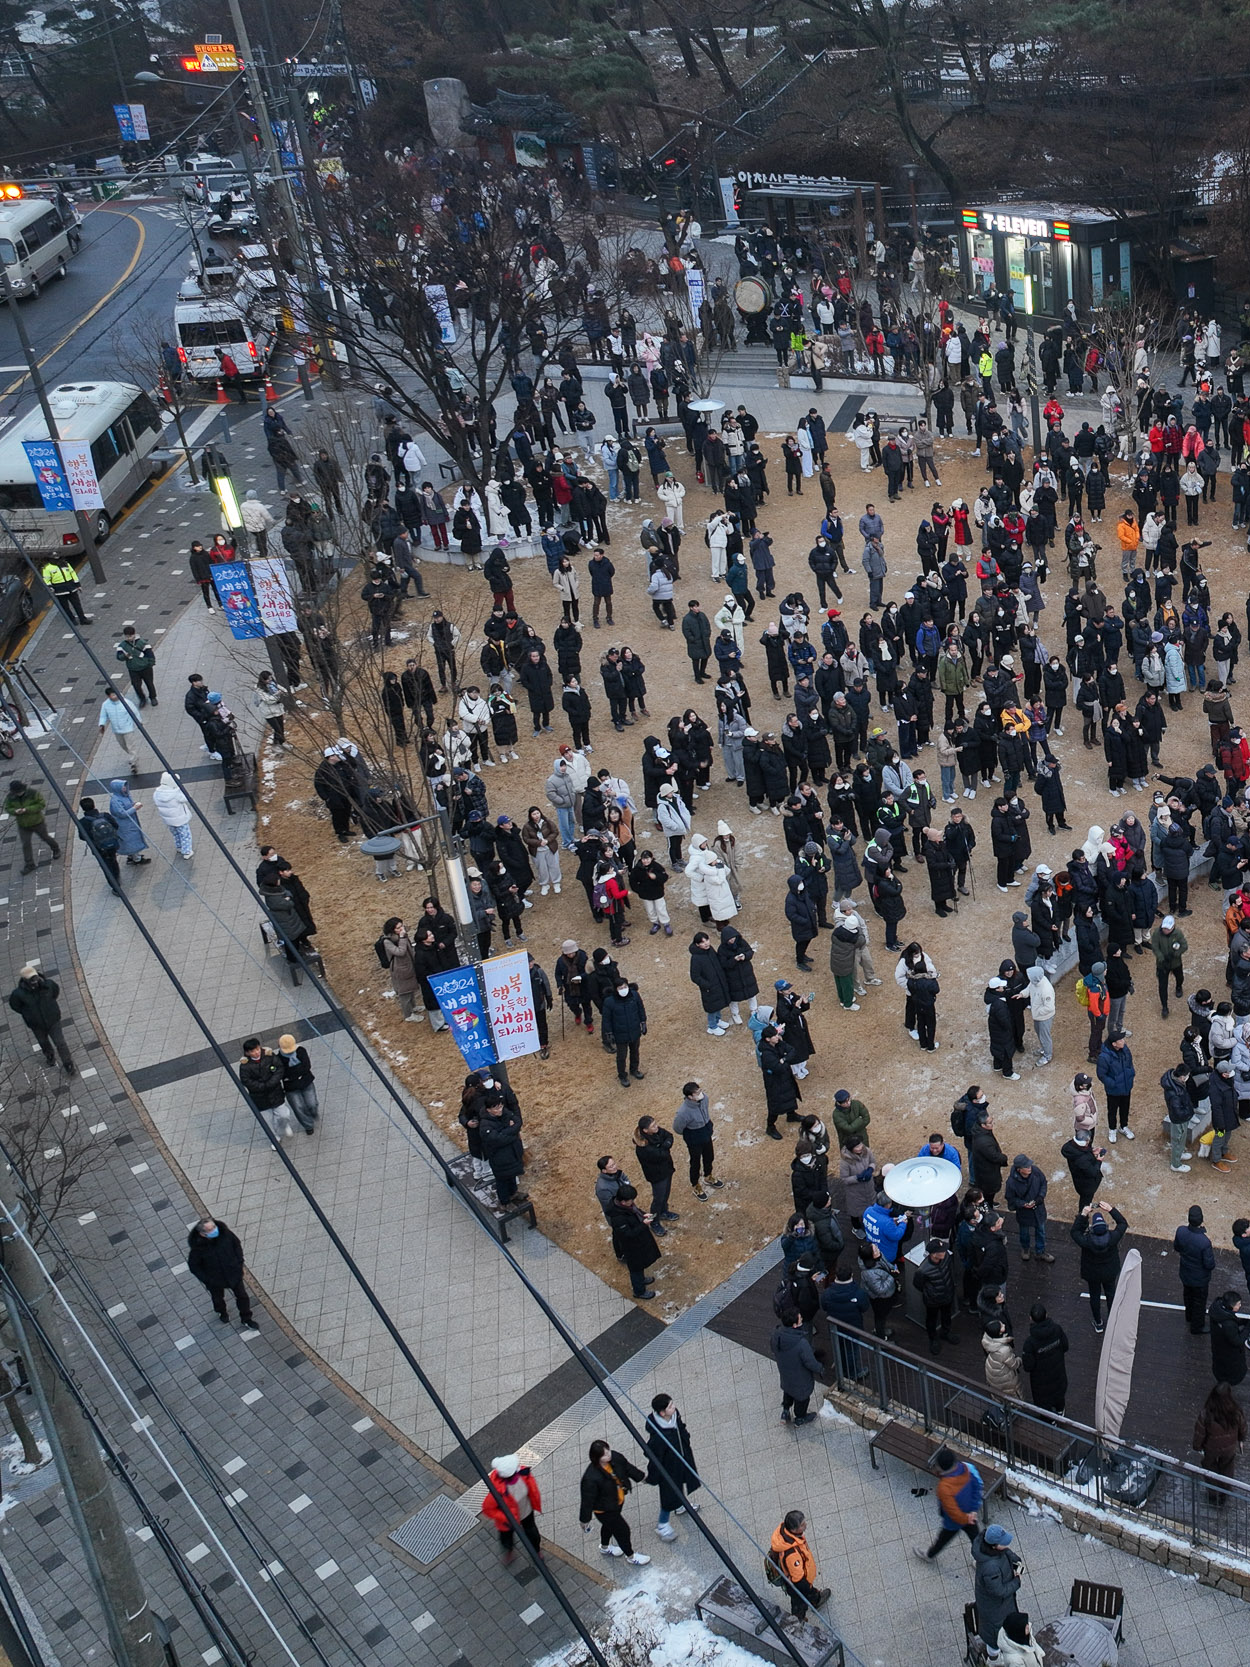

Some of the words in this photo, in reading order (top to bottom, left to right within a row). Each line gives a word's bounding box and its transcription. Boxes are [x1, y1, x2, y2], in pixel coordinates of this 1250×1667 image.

[34, 459, 58, 467] 새해
[67, 453, 89, 470] 행복
[71, 469, 94, 479] 가득한
[71, 479, 97, 488] 새해
[221, 580, 249, 591] 새해
[258, 572, 281, 591] 행복
[233, 595, 244, 610] 복
[261, 600, 291, 610] 새해
[265, 611, 293, 619] 되세요
[491, 972, 523, 1001] 행복
[495, 996, 528, 1012] 가득한
[454, 1011, 469, 1032] 복
[493, 1008, 534, 1026] 새해
[498, 1022, 535, 1038] 되세요
